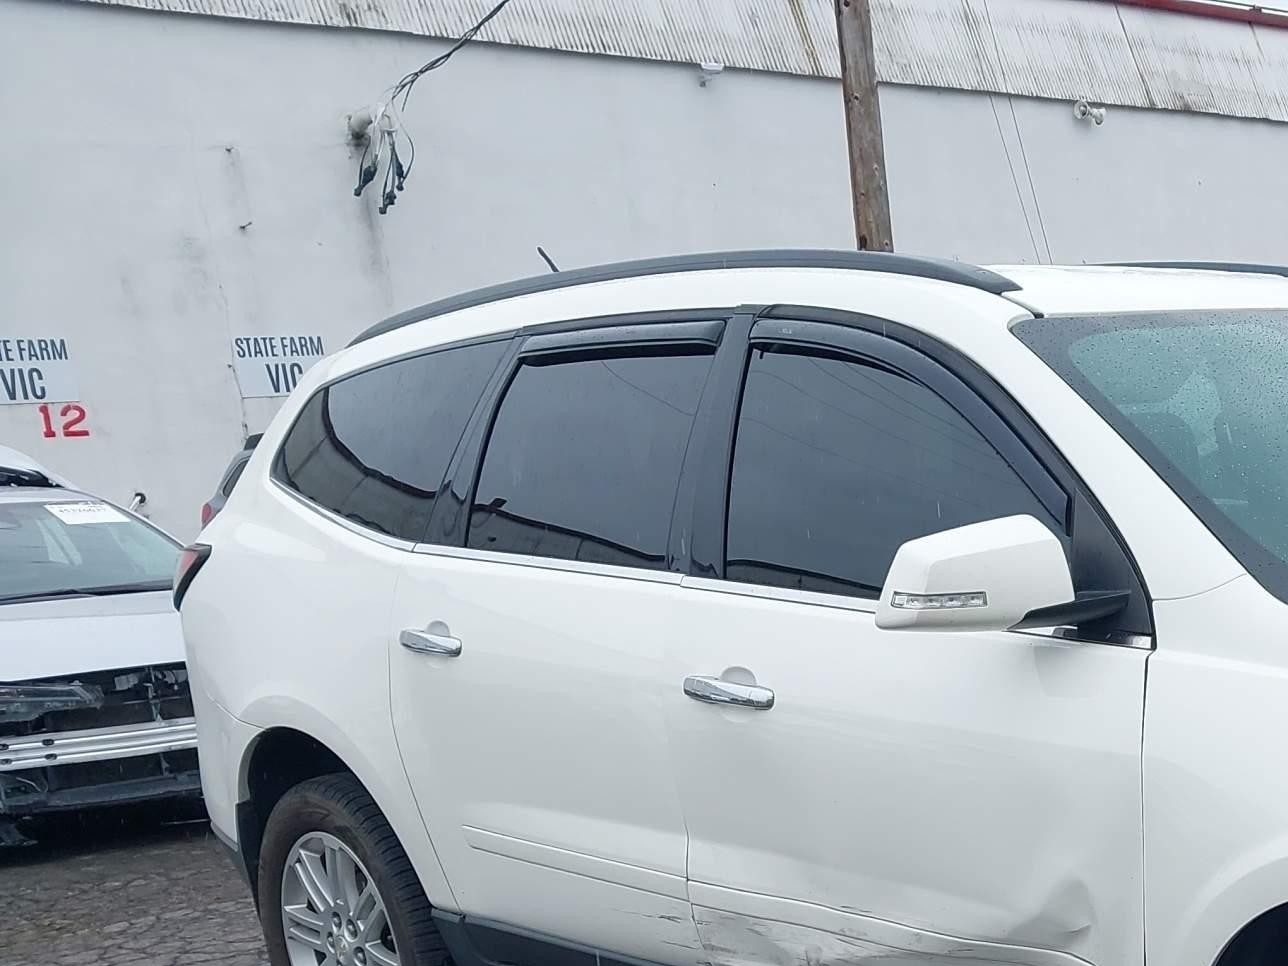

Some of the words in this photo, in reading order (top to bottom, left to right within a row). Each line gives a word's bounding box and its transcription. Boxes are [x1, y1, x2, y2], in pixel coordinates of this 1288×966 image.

[16, 338, 69, 361] FARM
[234, 336, 279, 358] STATE
[280, 335, 325, 357] FARM
[0, 367, 46, 401] VIC
[38, 403, 90, 438] 12
